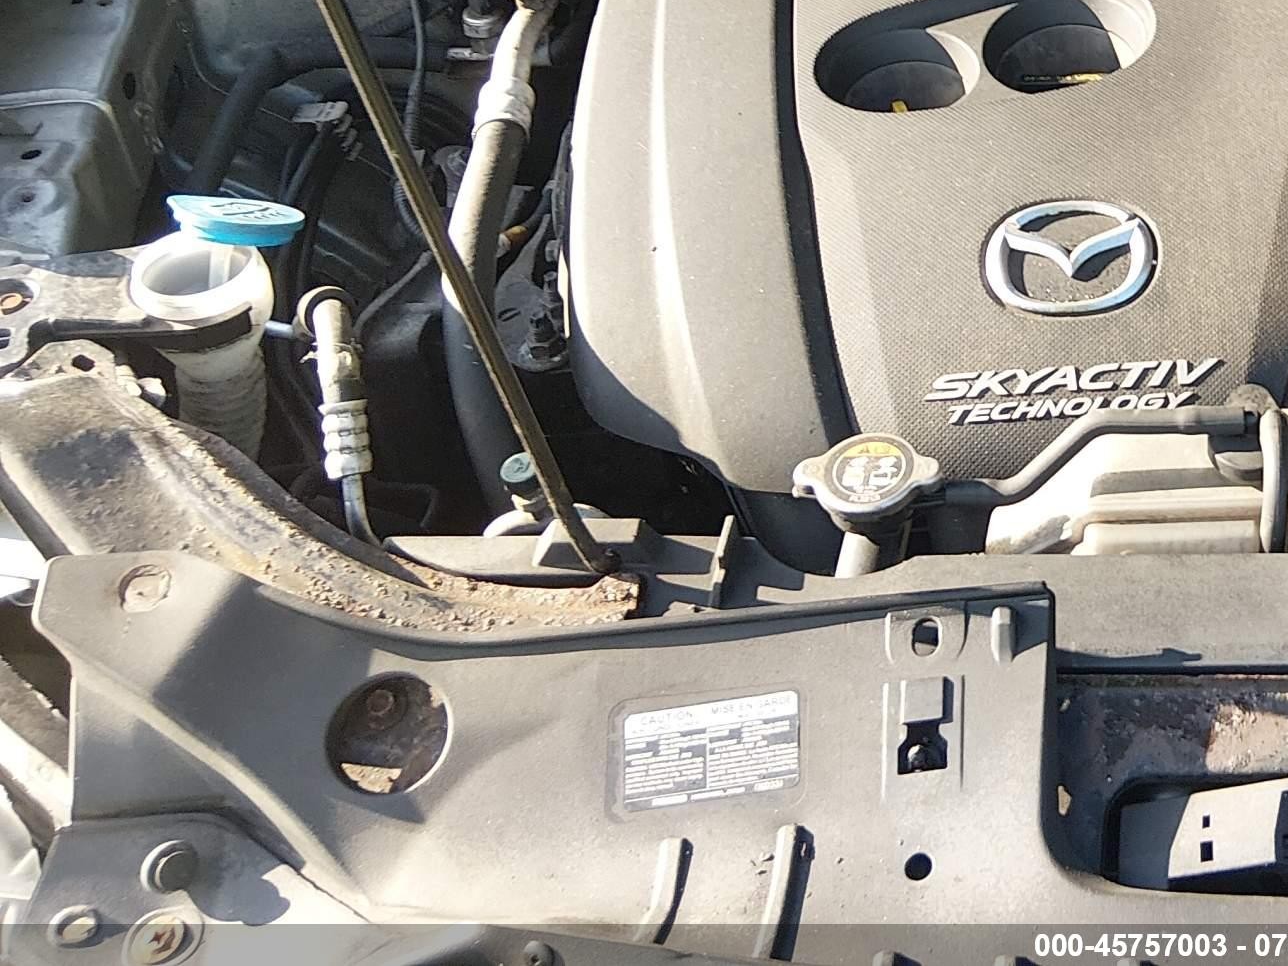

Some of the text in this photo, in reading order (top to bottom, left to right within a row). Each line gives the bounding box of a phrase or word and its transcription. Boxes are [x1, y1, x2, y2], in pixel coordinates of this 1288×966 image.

[926, 359, 1219, 401] SKYACTIV
[948, 392, 1194, 424] TECHNOLOGY
[640, 710, 693, 726] CAUTION
[711, 703, 734, 715] MISE
[738, 700, 753, 712] EN
